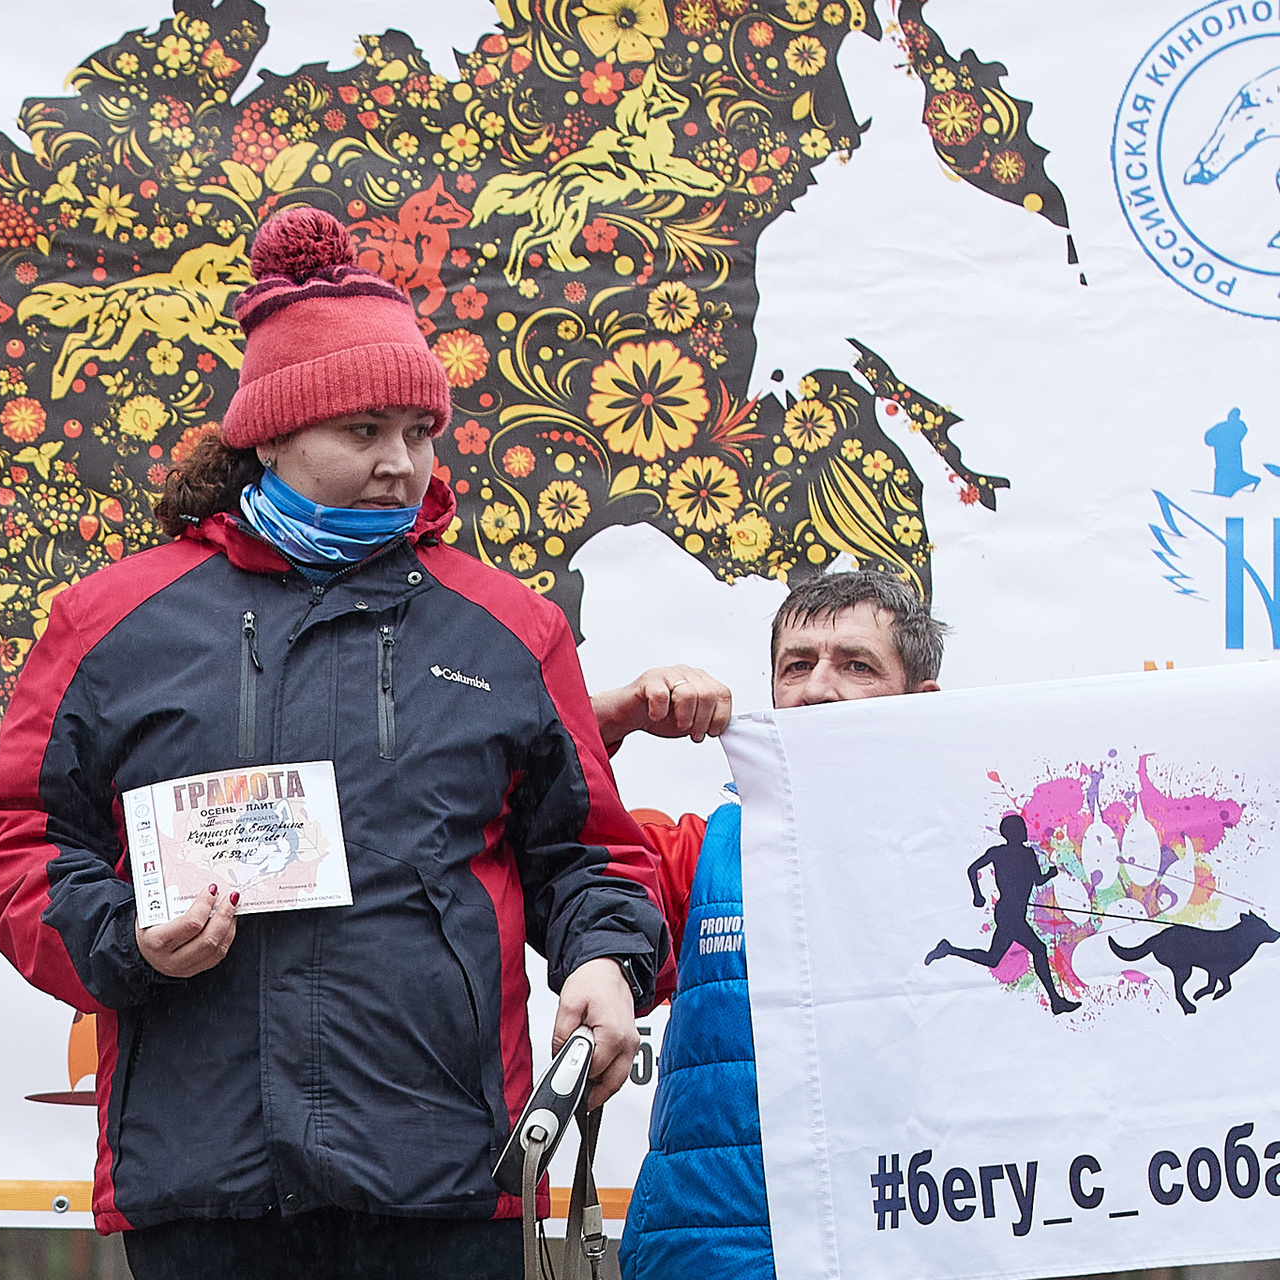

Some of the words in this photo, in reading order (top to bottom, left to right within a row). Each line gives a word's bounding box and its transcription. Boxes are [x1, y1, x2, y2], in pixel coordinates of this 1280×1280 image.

[1145, 0, 1280, 87] КИНОЛО
[1123, 93, 1237, 297] РОССИЙСКАЯ
[442, 667, 492, 692] Columbia
[172, 770, 306, 812] ГРАМОТА
[200, 806, 237, 818] ОСЕНЬ
[698, 934, 743, 956] ROMAN
